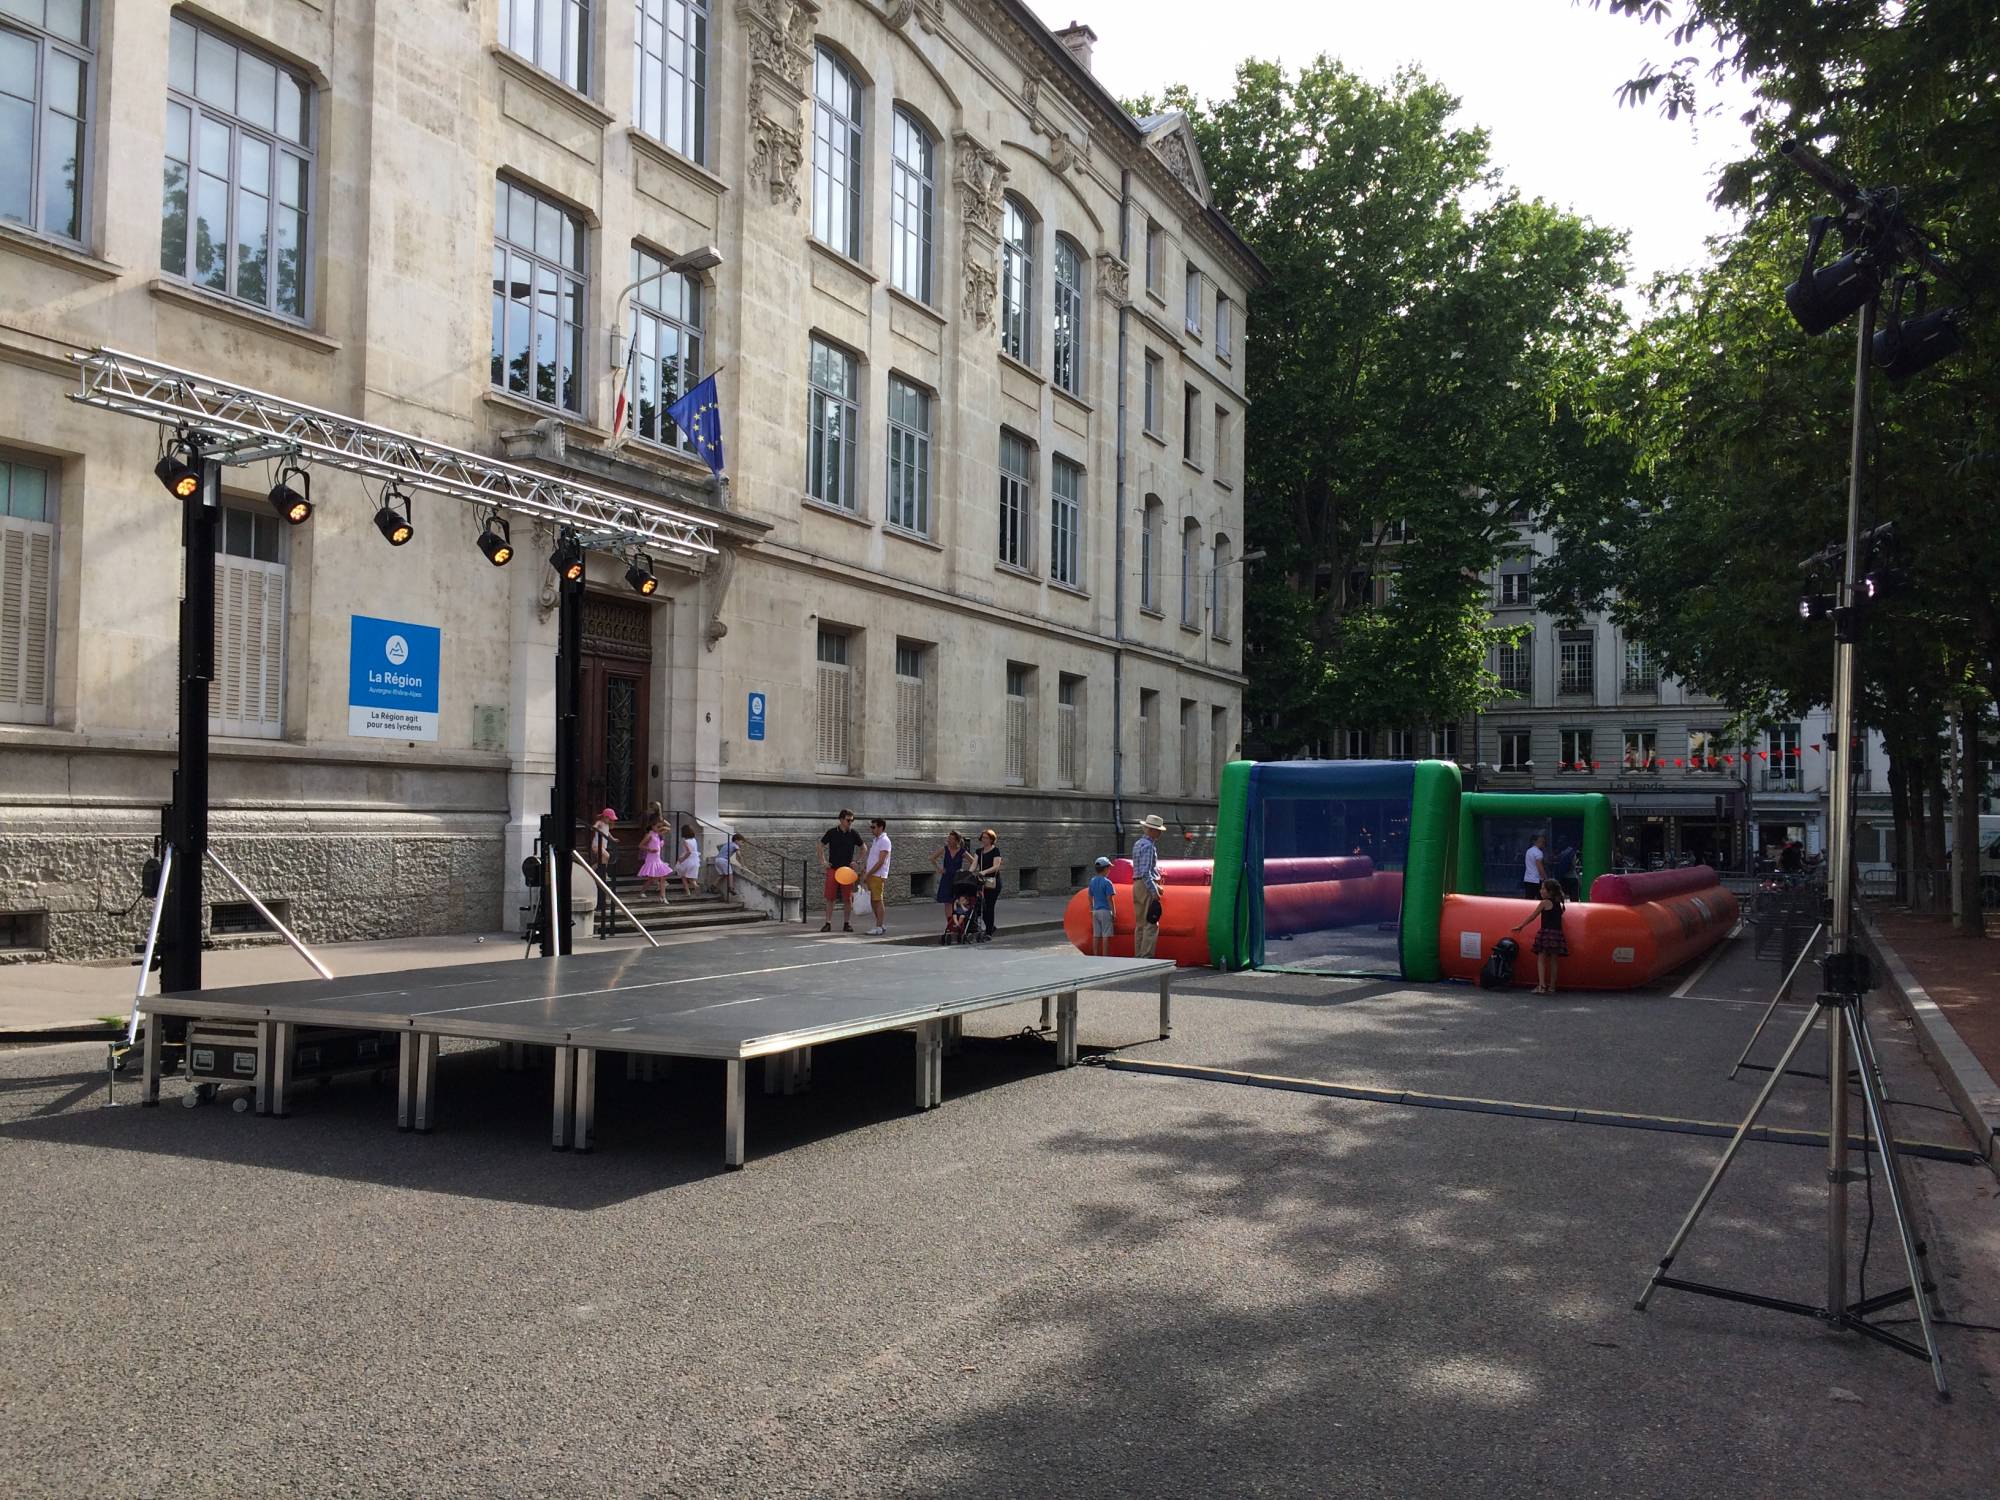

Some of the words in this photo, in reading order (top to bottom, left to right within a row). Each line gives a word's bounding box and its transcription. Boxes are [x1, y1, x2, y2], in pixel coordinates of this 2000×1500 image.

[369, 670, 382, 683] La
[384, 672, 422, 688] Région
[381, 712, 405, 722] Région
[405, 715, 418, 723] agit
[706, 712, 712, 723] 6
[396, 723, 422, 731] lycéens
